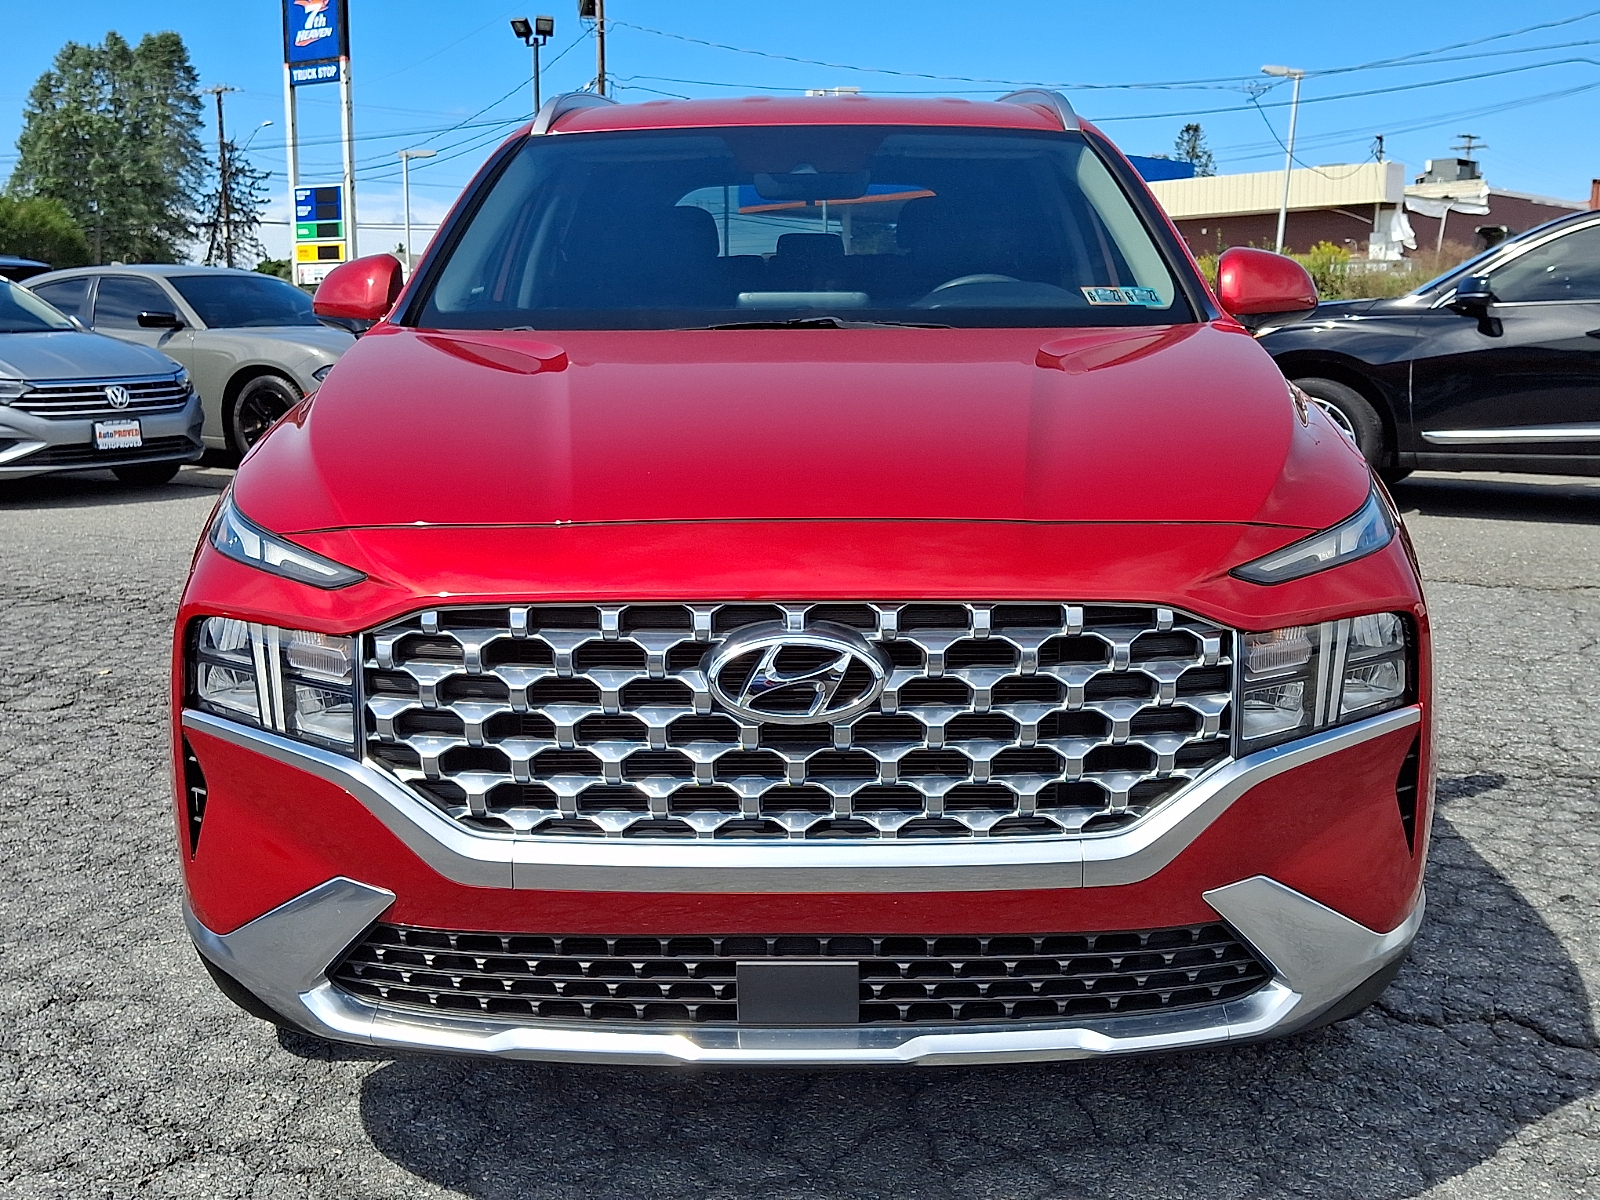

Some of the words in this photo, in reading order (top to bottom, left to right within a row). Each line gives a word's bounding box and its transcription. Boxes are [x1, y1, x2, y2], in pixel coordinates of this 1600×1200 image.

[305, 4, 326, 29] 7th
[295, 27, 333, 43] HEAVEN
[292, 68, 317, 81] TRUCK
[317, 65, 337, 78] STOP
[98, 429, 140, 439] AutoPROVED
